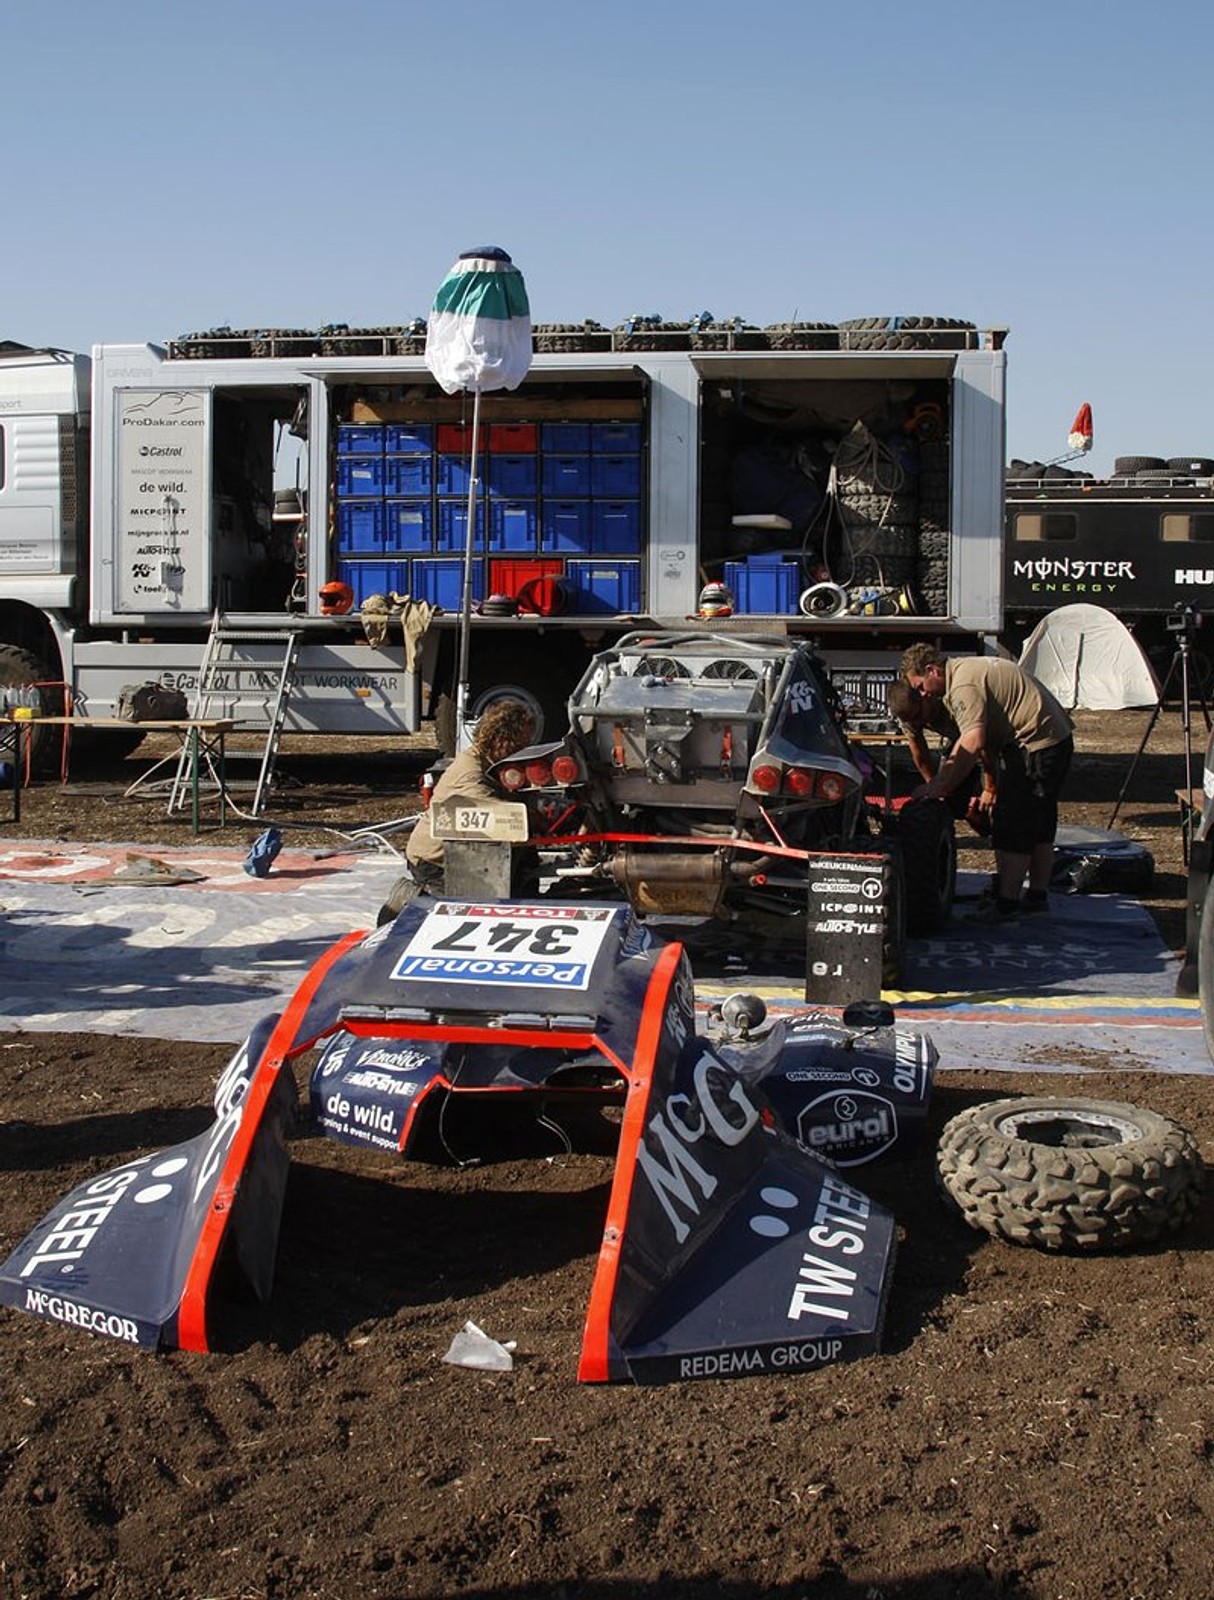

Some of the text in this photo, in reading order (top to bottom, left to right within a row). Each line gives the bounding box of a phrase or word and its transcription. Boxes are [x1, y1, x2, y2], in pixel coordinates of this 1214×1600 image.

[123, 417, 205, 427] ProDakar.com
[149, 446, 183, 457] Castrol
[139, 480, 187, 493] de wild.
[1013, 557, 1136, 580] MONSTER
[1031, 582, 1117, 593] ENERGY
[248, 674, 308, 687] MASOT
[314, 674, 398, 690] WORKWEAR
[460, 811, 490, 829] 347
[475, 906, 577, 920] TOTAL
[431, 920, 580, 956] 347
[402, 957, 582, 982] Personal
[327, 1092, 398, 1136] de wild.
[349, 1127, 371, 1141] event
[808, 1109, 891, 1146] eurol
[19, 1171, 139, 1278] STEEL
[787, 1252, 858, 1321] TW
[25, 1288, 140, 1344] McGREGOR
[680, 1339, 843, 1380] REDEMA GROUP
